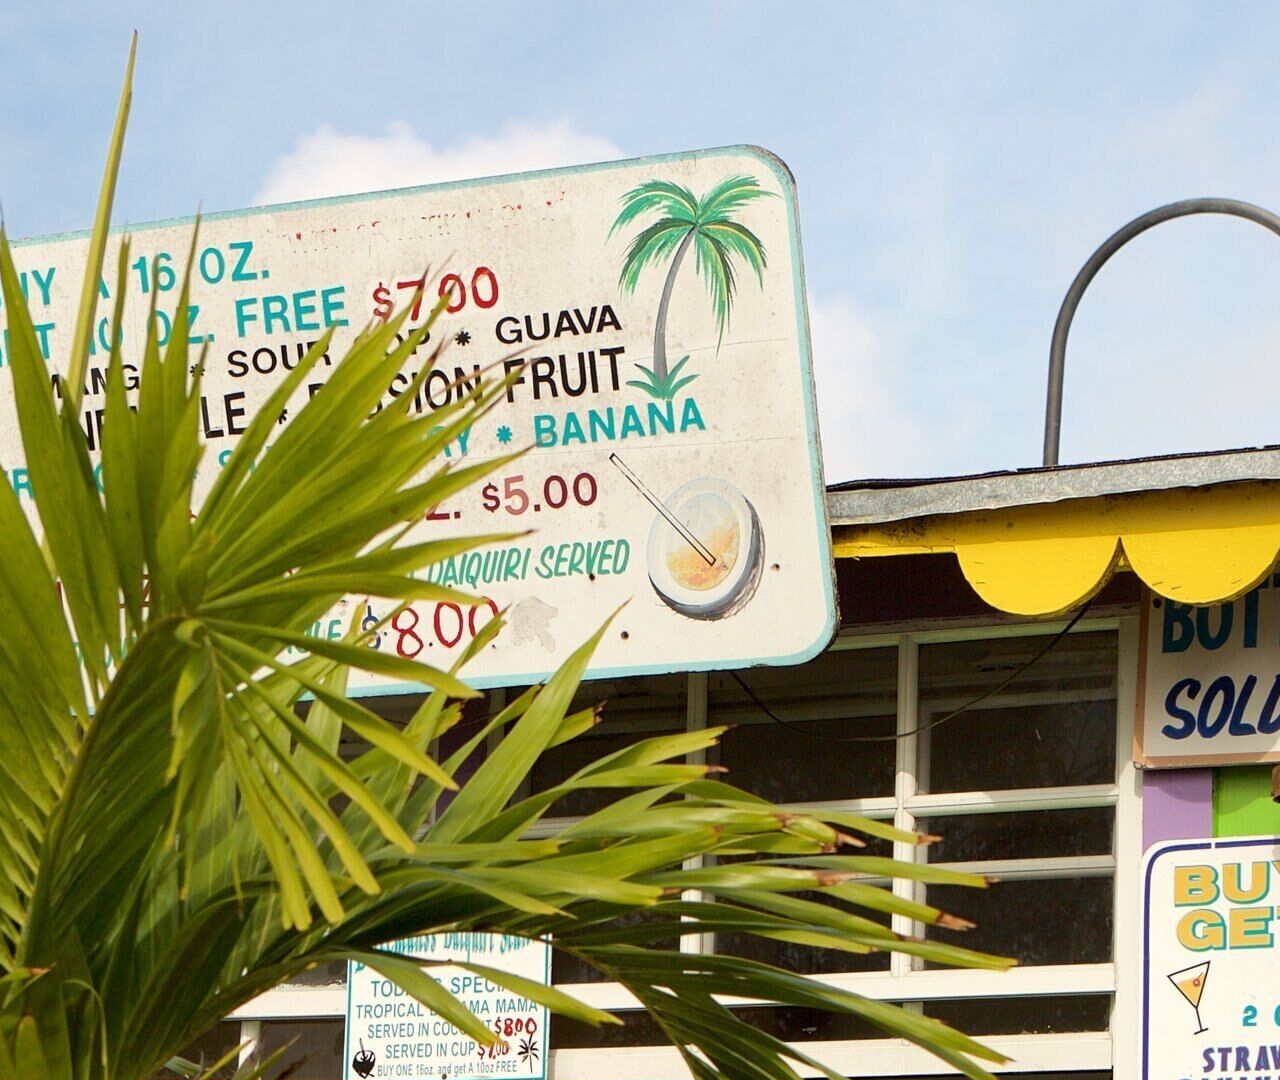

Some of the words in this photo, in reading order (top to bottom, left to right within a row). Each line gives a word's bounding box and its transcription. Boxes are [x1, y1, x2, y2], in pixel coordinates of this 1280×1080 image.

[199, 241, 270, 284] OZ.
[235, 286, 348, 338] FREE
[495, 305, 622, 344] GUAVA
[503, 346, 626, 403] FRUIT
[534, 397, 706, 449] BANANA
[481, 472, 598, 516] $5.00
[535, 540, 630, 580] SERVED
[356, 1004, 424, 1019] TROPICAL
[496, 998, 538, 1013] MAMA
[368, 1022, 414, 1039] SERVED
[418, 1022, 429, 1037] IN
[495, 1017, 537, 1036] $8.00
[1242, 1006, 1258, 1027] 2
[377, 1064, 394, 1077] BUY
[396, 1063, 413, 1076] ONE
[454, 1063, 467, 1077] get
[468, 1063, 474, 1073] A
[496, 1060, 517, 1073] FREE
[386, 1043, 434, 1059] SERVED
[437, 1043, 447, 1057] IN
[452, 1042, 475, 1057] CUP
